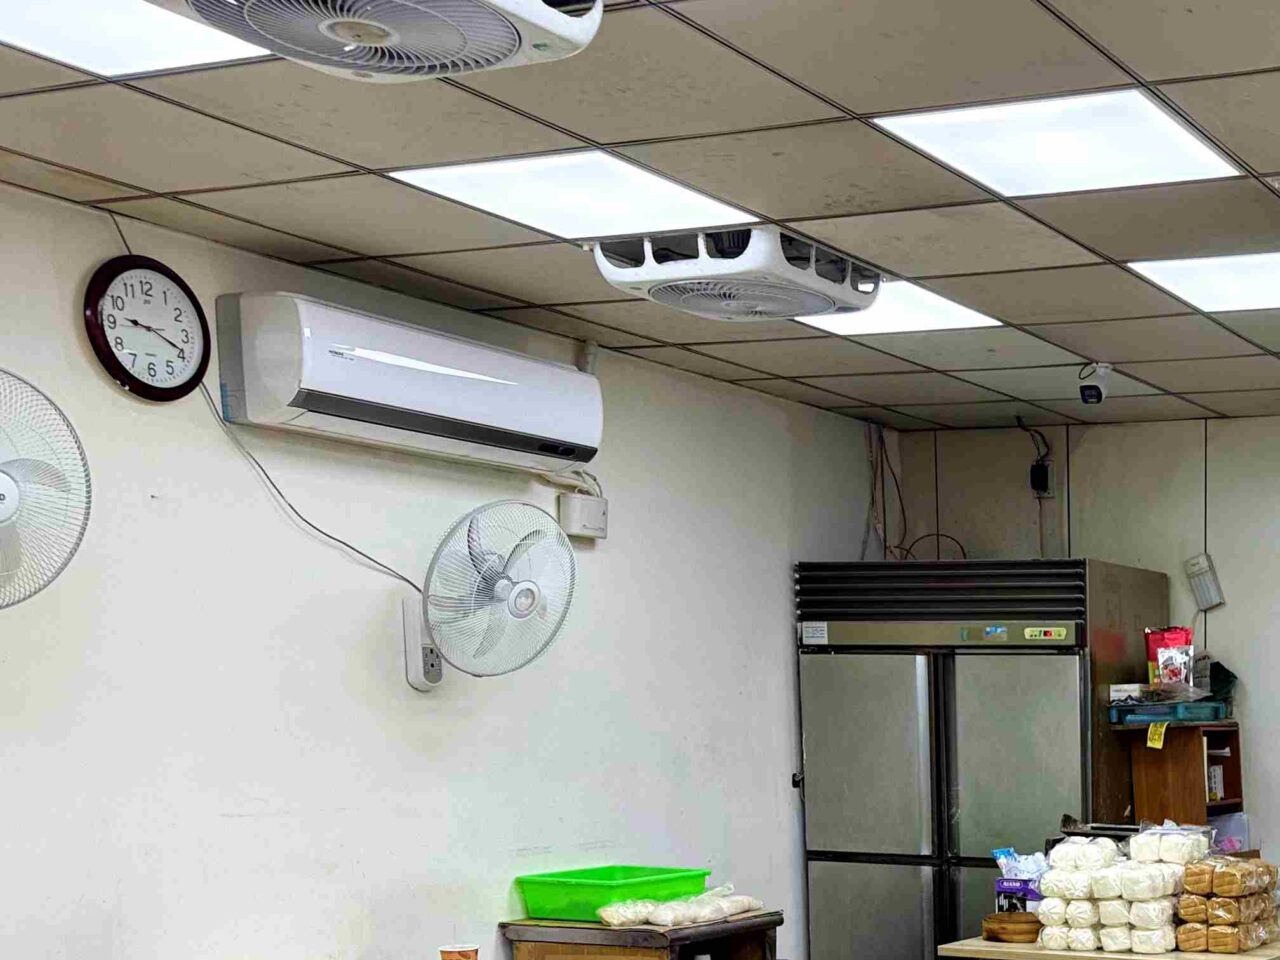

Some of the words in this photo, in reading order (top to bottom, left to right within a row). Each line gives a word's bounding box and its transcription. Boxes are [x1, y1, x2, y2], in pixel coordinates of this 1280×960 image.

[123, 282, 135, 299] 11
[139, 280, 153, 298] 12
[110, 295, 125, 311] 10
[107, 314, 117, 330] 9
[173, 307, 183, 323] 2
[114, 336, 124, 352] 8
[181, 329, 190, 345] 3
[128, 353, 138, 368] 7
[177, 348, 186, 362] 4
[147, 362, 157, 378] 6
[165, 360, 175, 376] 5
